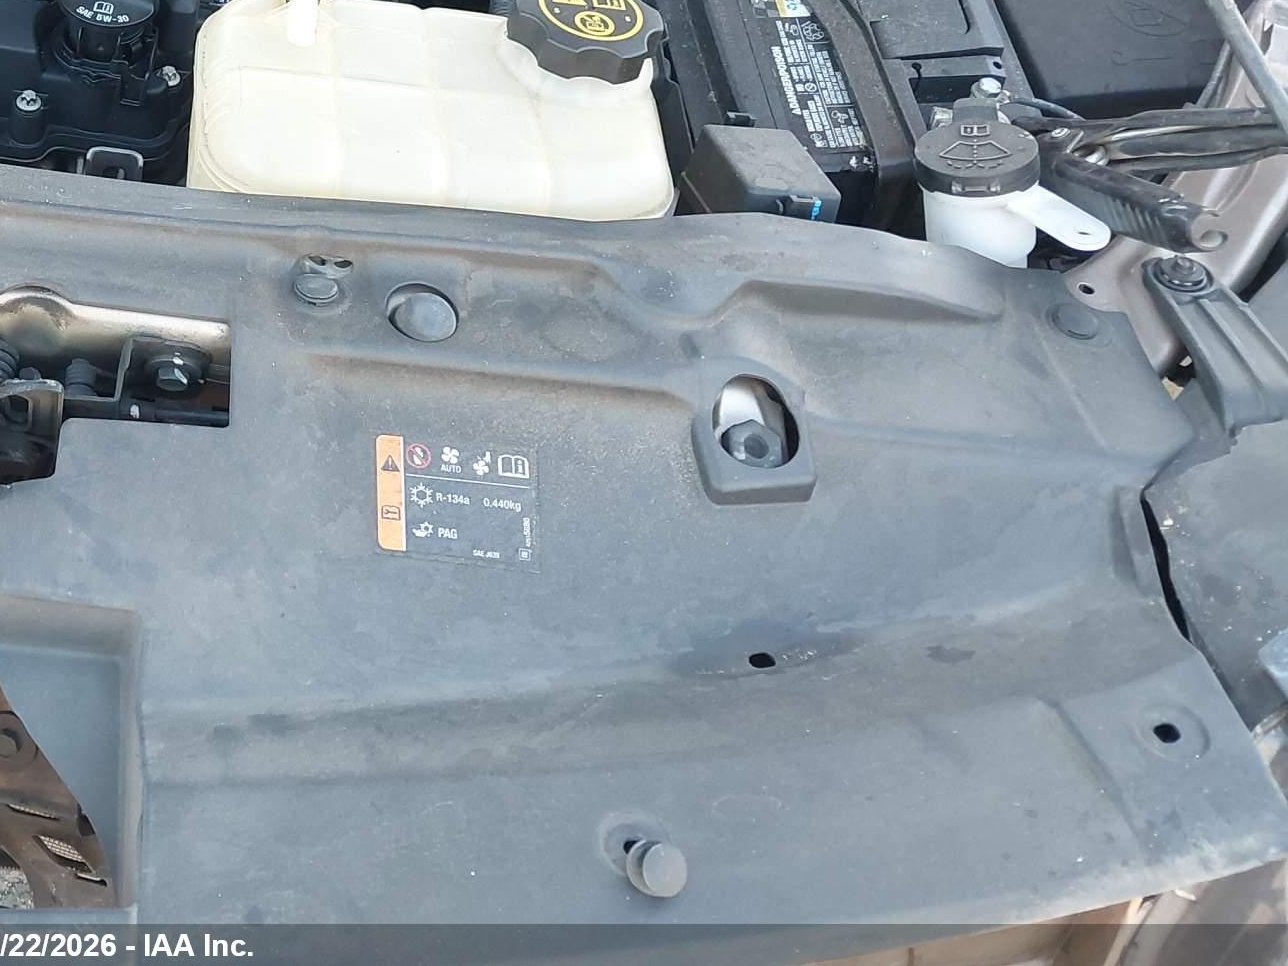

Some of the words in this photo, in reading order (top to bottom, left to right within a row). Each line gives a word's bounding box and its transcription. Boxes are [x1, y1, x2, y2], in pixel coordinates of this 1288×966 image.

[75, 6, 94, 19] SAE
[96, 14, 130, 23] 5W-30
[440, 464, 462, 474] AUTO
[436, 492, 470, 505] R-134a
[483, 497, 522, 513] 0.440kg
[437, 527, 458, 540] PAG
